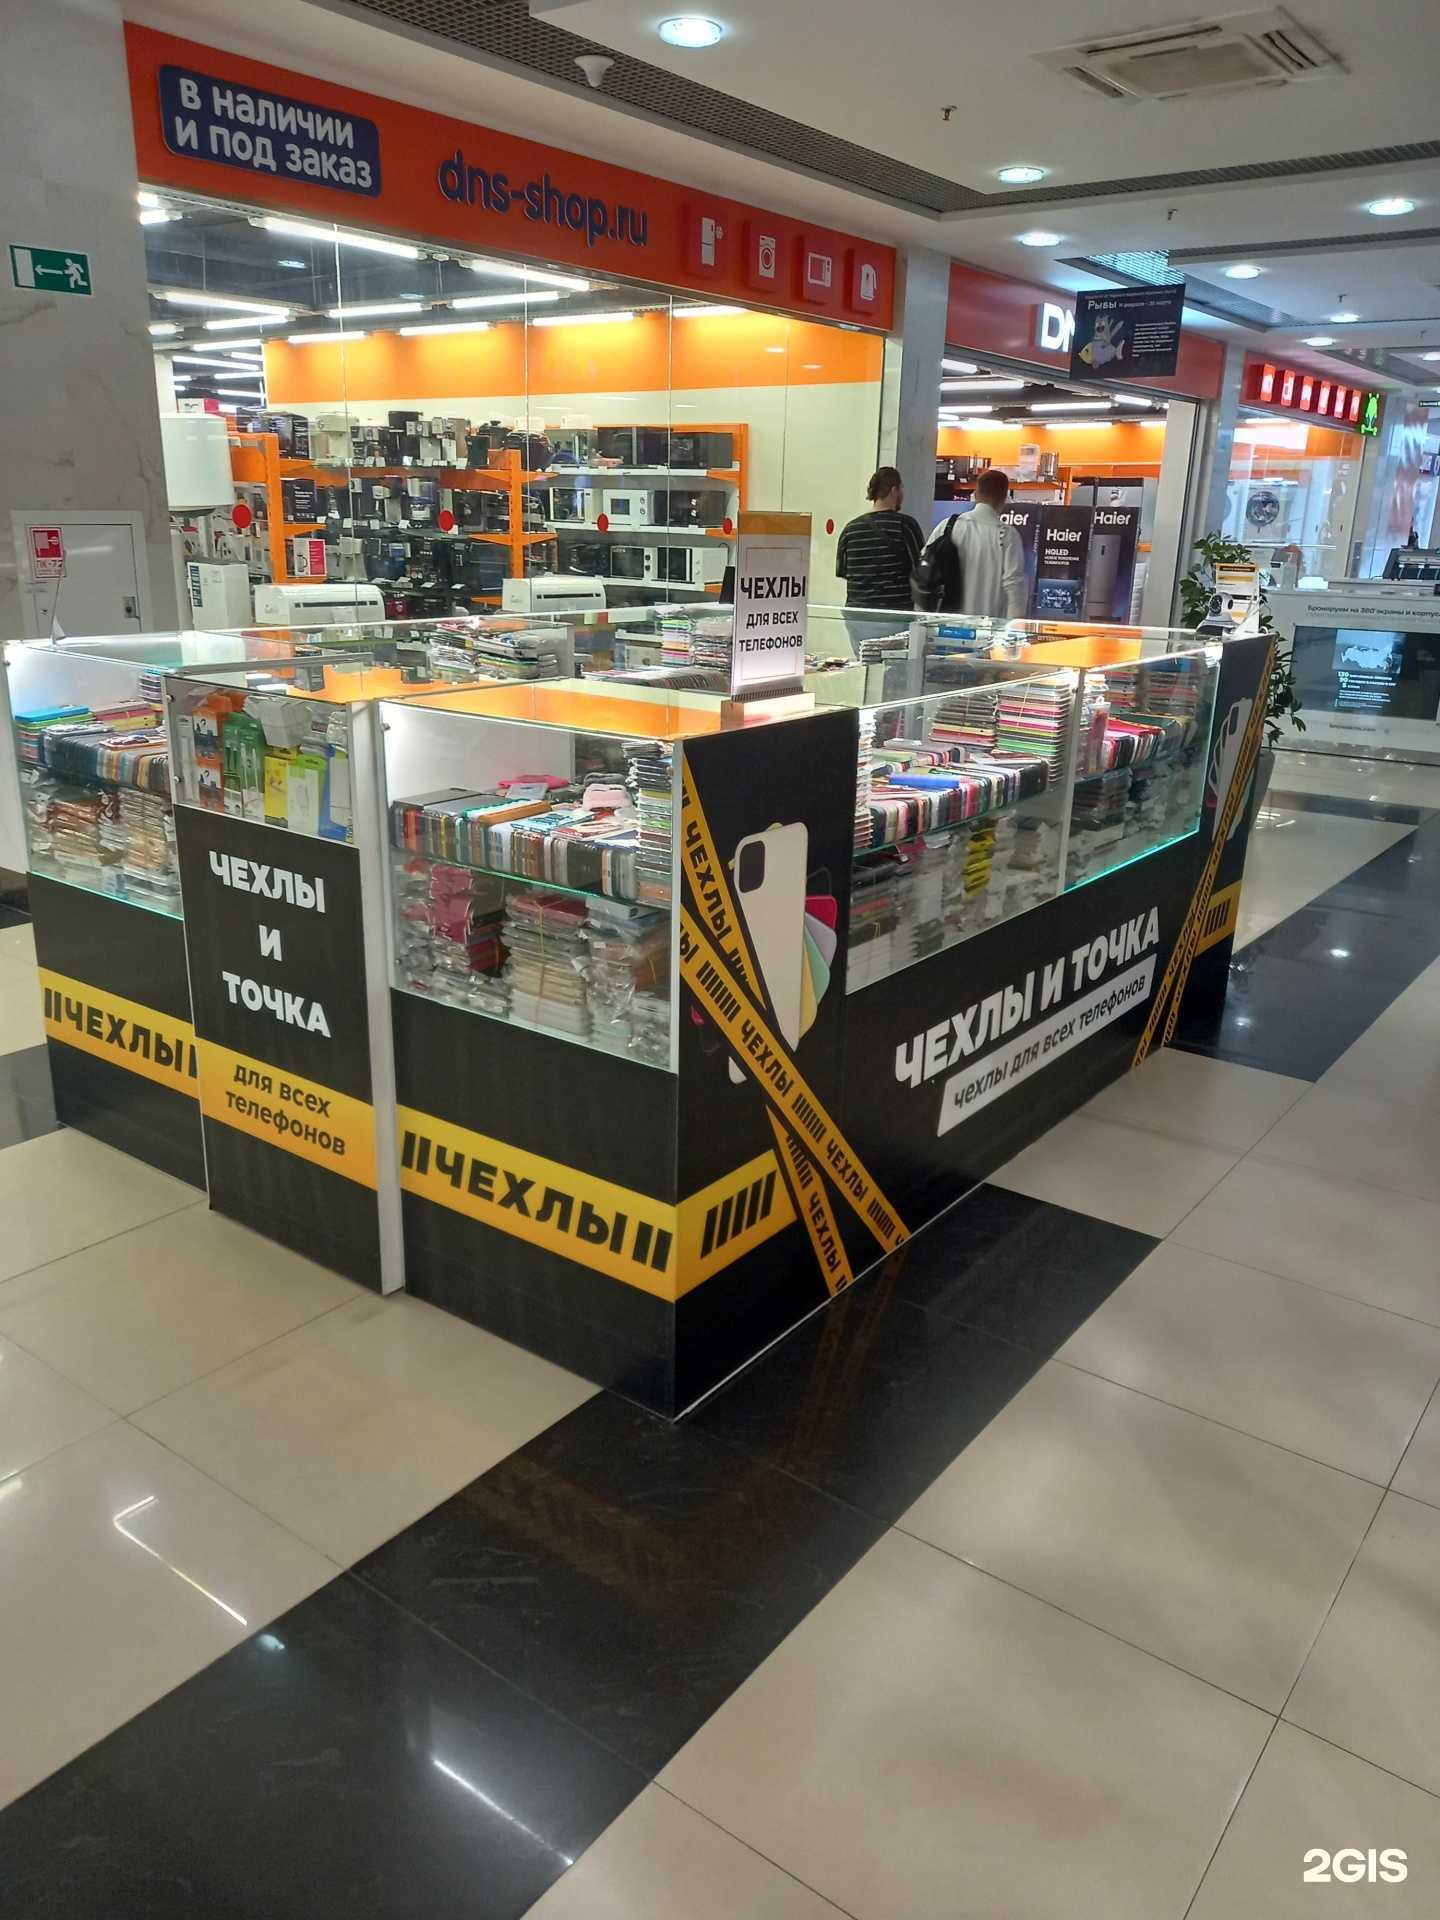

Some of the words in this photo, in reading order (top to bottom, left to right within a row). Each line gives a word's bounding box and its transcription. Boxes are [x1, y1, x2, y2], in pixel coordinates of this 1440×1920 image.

[212, 86, 354, 149] наличии
[174, 115, 199, 150] и
[209, 125, 277, 172] под
[284, 143, 373, 189] заказ
[437, 148, 648, 248] dns-shop.ru
[1000, 510, 1029, 526] aier
[1046, 529, 1082, 542] Haier
[1094, 511, 1131, 525] Haier
[740, 576, 806, 599] ЧЕХЛЫ
[746, 612, 769, 629] ДЛЯ
[772, 611, 799, 626] ВСЕХ
[739, 635, 803, 652] ТЕЛЕФОНОВ
[209, 850, 326, 913] ЧЕХЛЫ
[685, 820, 732, 945] ЧЕХЛЫ
[258, 924, 282, 961] И
[222, 970, 331, 1038] ТОЧКА
[895, 970, 1036, 1089] ЧЕХЛЫ
[1040, 956, 1066, 1012] И
[1071, 906, 1160, 992] ТОЧКА
[64, 1000, 183, 1074] ЧЕХЛЫ
[740, 1021, 794, 1098] ЧЕХЛЫ
[954, 1061, 1008, 1108] чехлы
[1010, 1045, 1040, 1082] для
[1079, 973, 1146, 1027] телефонов
[225, 1091, 346, 1156] телефонов
[436, 1144, 628, 1254] ЧЕХЛЫ
[826, 1138, 869, 1202] ЧЕХЛЫ
[808, 1192, 840, 1274] ЧЕХЛЫ
